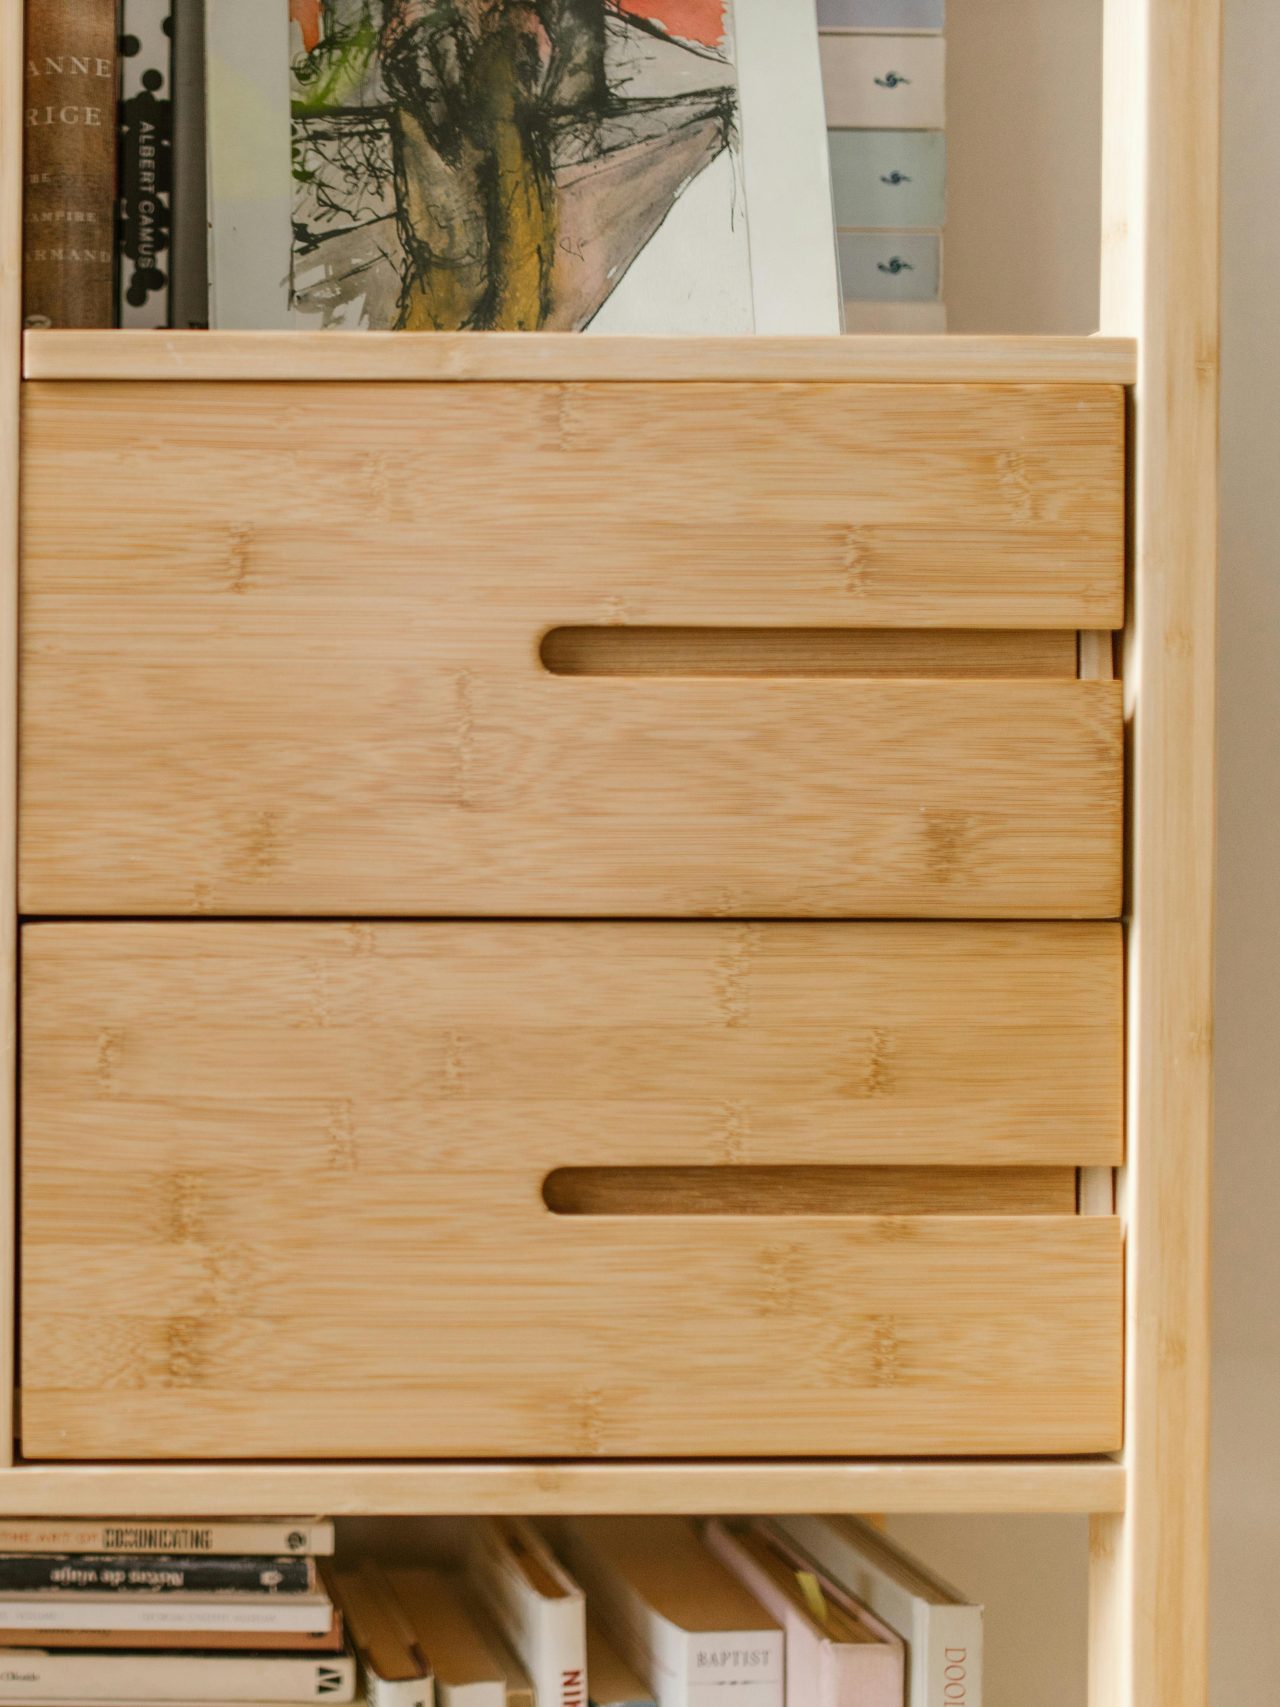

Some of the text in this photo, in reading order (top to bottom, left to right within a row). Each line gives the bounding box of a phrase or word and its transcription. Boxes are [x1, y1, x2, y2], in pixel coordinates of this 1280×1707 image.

[27, 56, 112, 78] ANNE
[137, 121, 156, 268] ALBERT CAMUS
[29, 211, 97, 223] AMPIRE
[99, 1569, 126, 1587] de
[696, 1649, 769, 1668] BAPTIST
